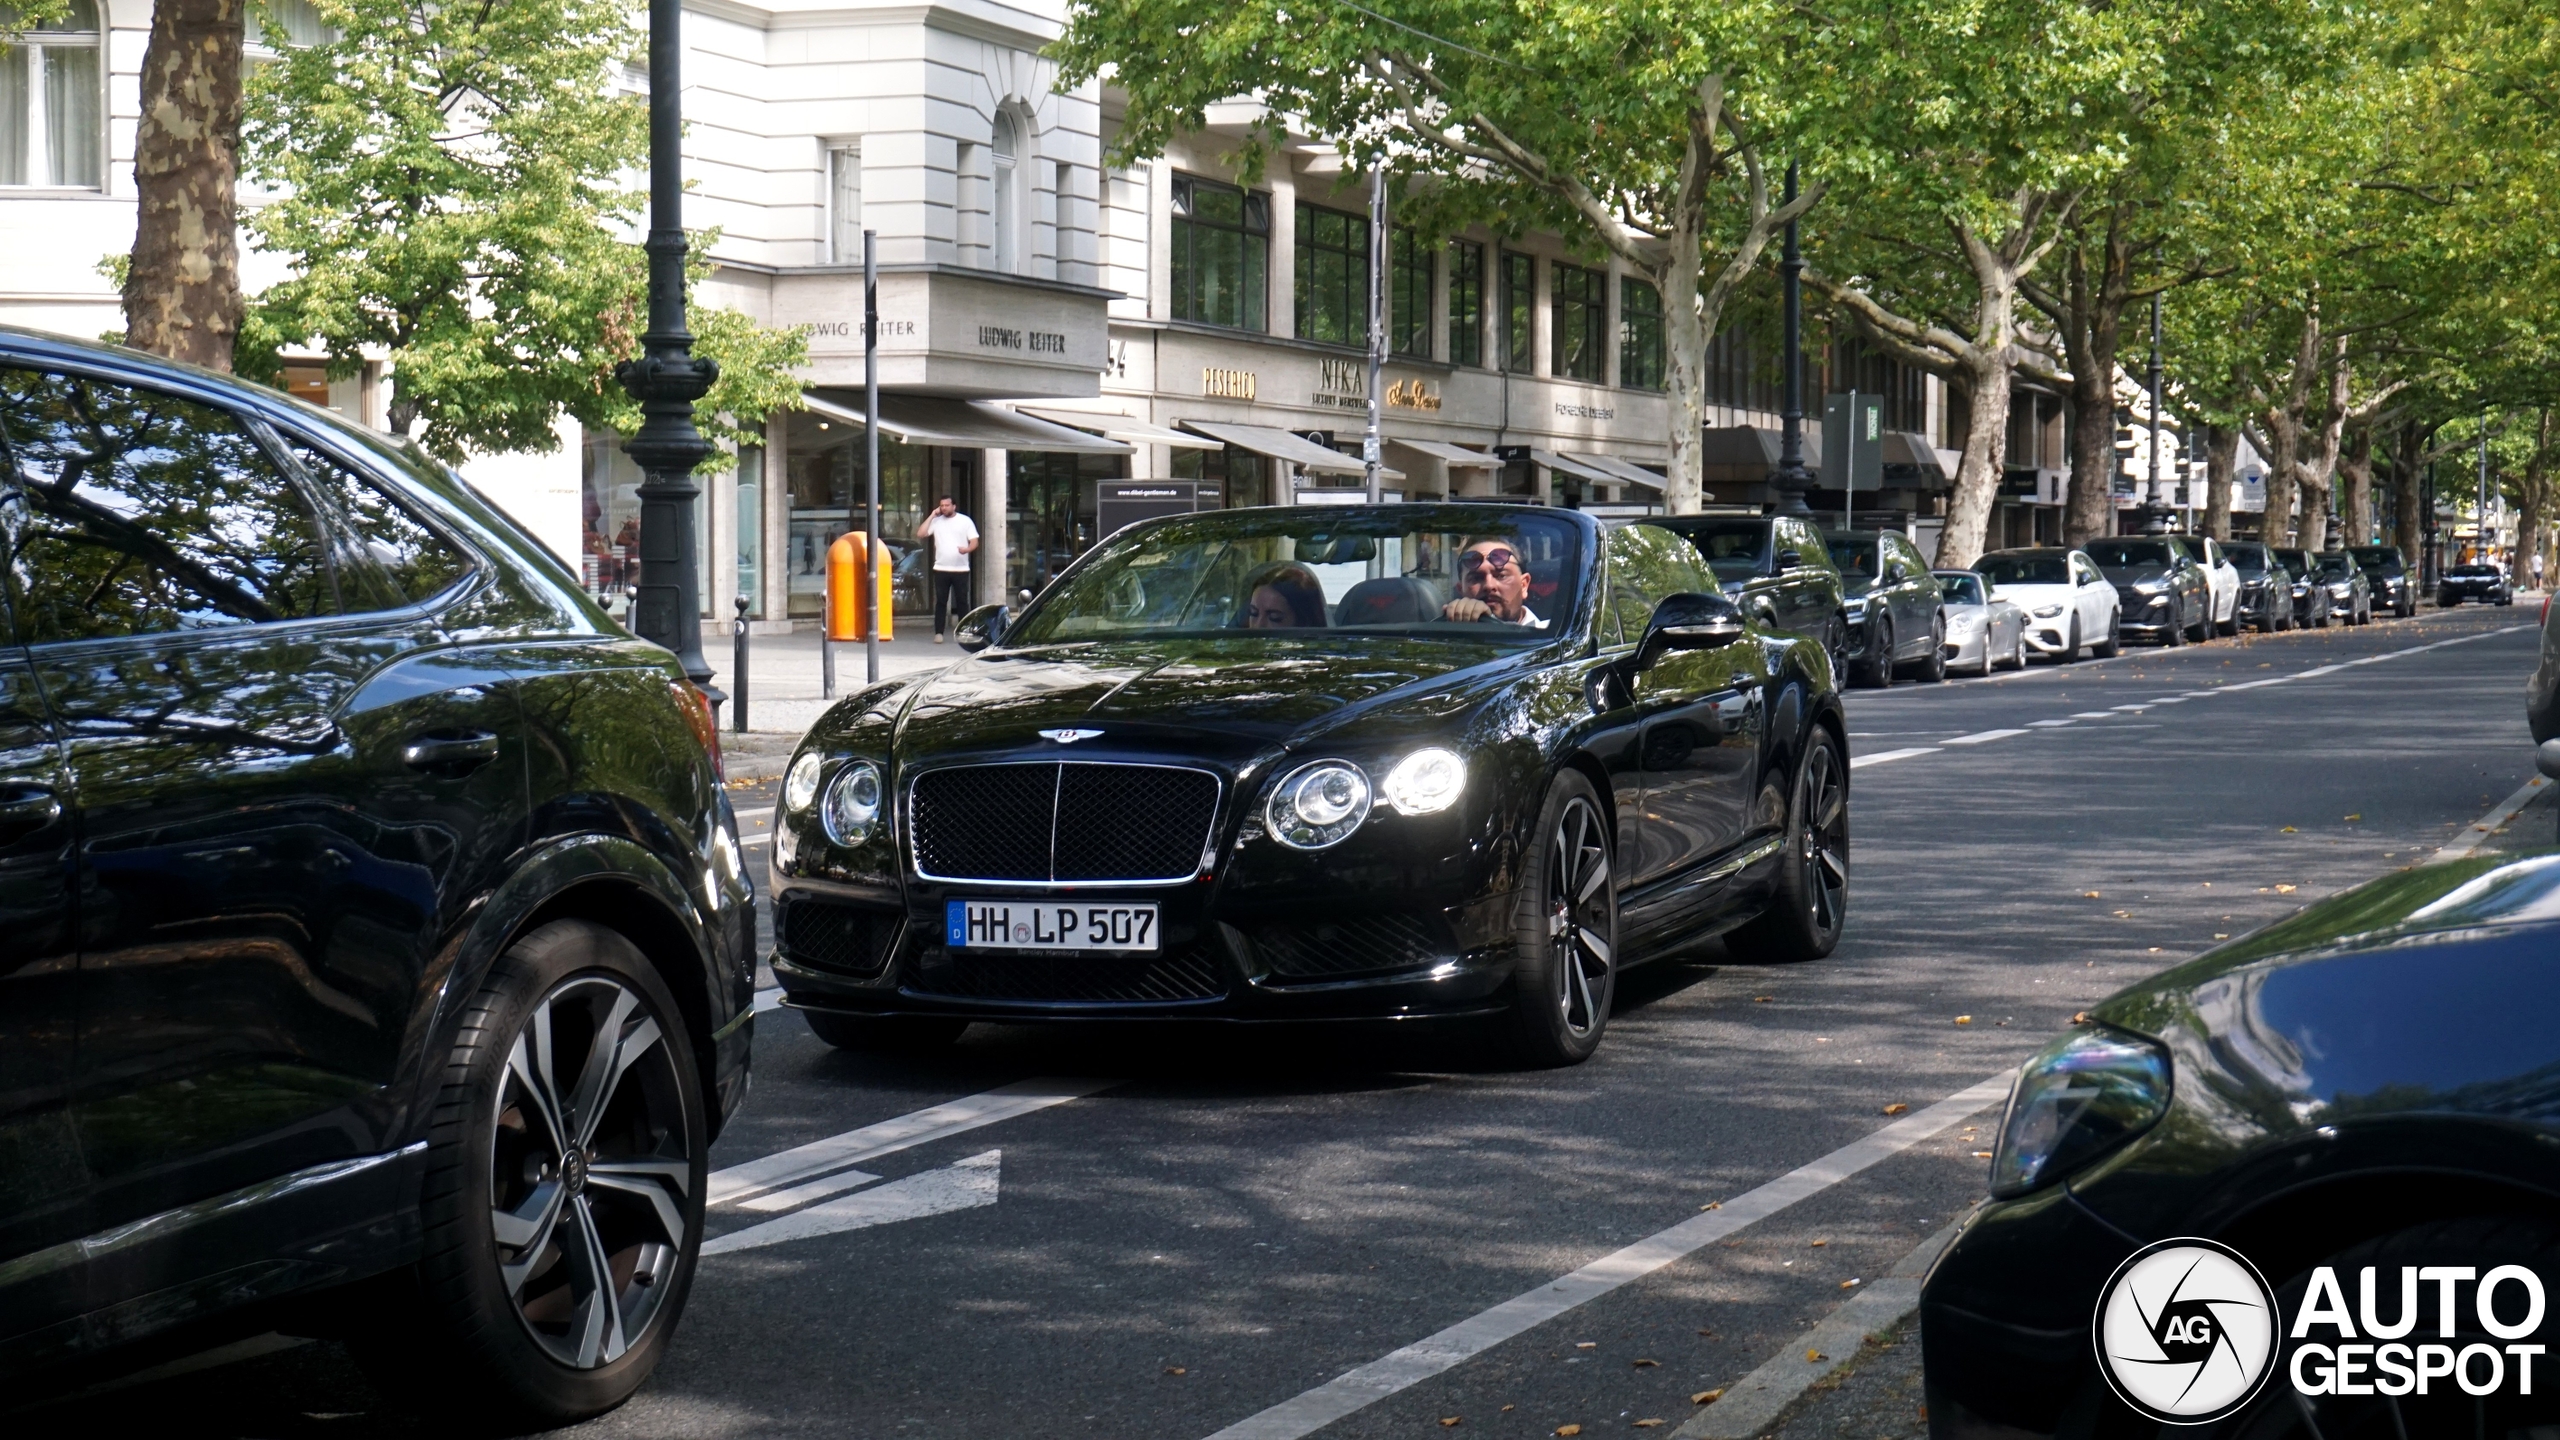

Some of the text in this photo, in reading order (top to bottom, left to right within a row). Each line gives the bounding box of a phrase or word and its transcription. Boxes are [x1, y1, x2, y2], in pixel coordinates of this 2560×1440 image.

[787, 321, 916, 337] DWIG RITER
[979, 325, 1066, 354] LUDWIG REITER
[1203, 367, 1256, 399] PESERICO
[1320, 359, 1362, 393] NIKA
[1311, 392, 1370, 409] LUXURY MENSWEA
[953, 928, 961, 940] D
[967, 906, 1155, 944] HH LP 507
[1046, 948, 1080, 958] Hamburg
